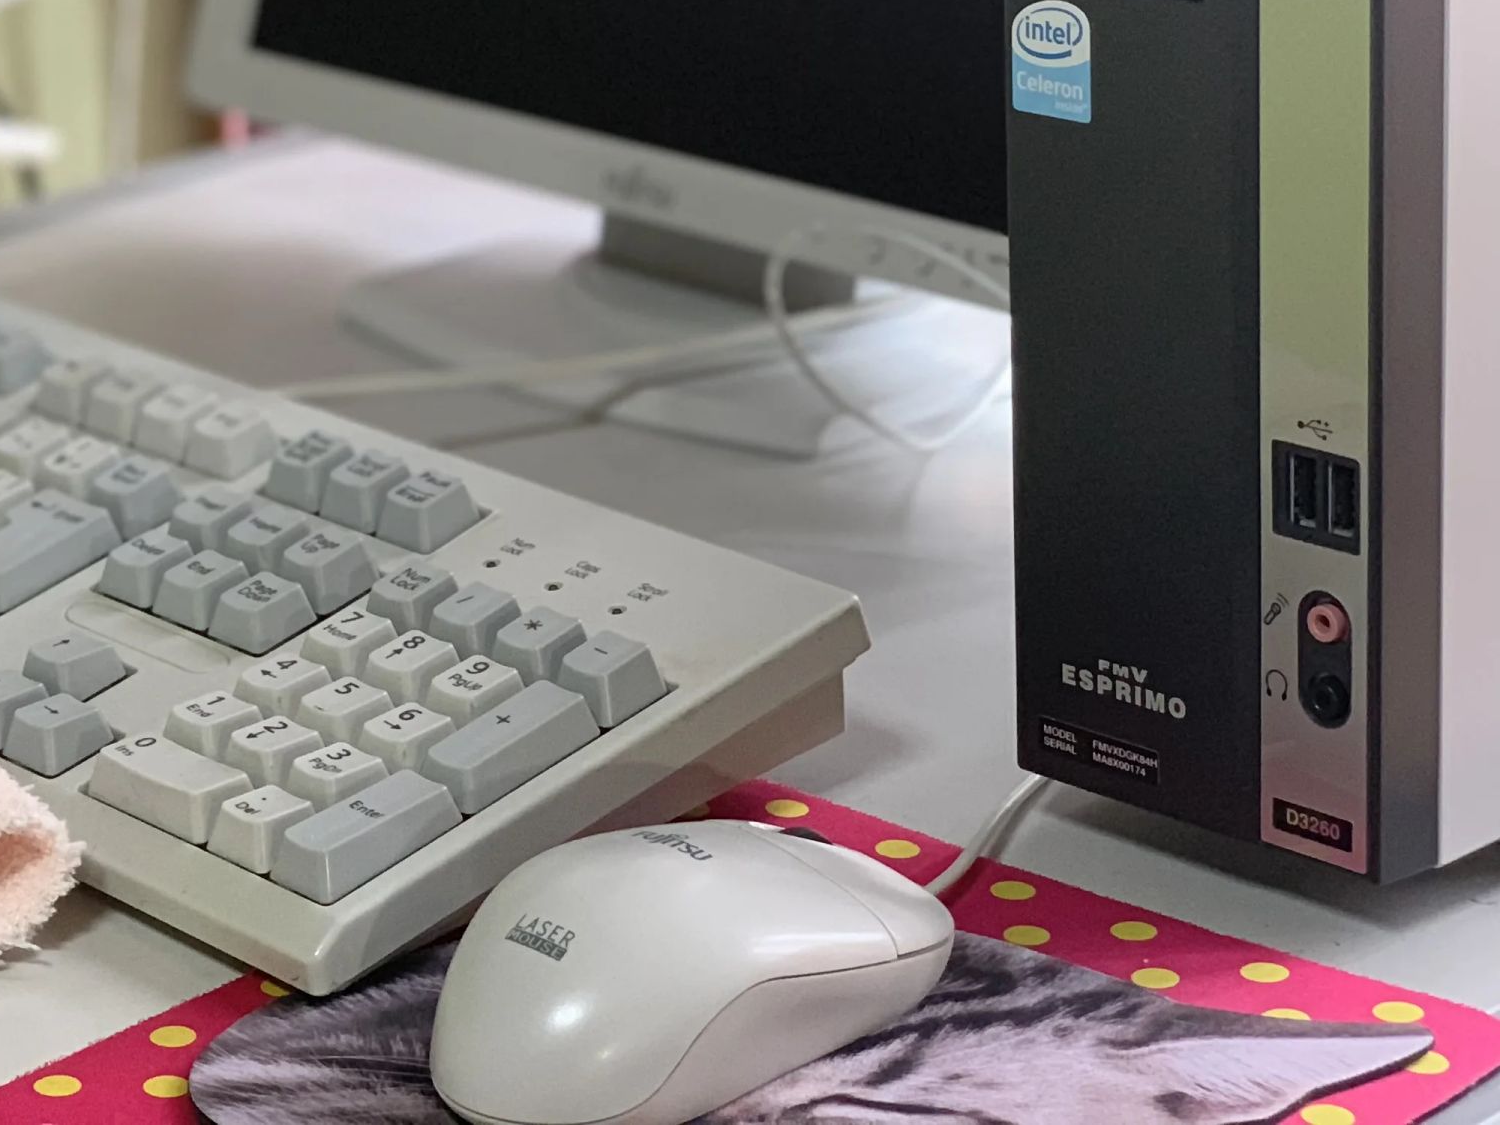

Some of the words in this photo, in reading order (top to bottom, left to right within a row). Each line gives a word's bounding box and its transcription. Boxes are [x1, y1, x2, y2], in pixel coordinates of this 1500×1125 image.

[1025, 15, 1072, 45] intel
[1016, 70, 1084, 100] Celeron
[389, 575, 421, 592] Lock
[403, 567, 432, 584] Num
[340, 611, 364, 624] 7
[322, 623, 358, 641] Home
[403, 635, 426, 649] 8
[276, 658, 298, 670] 4
[465, 661, 490, 675] 9
[1098, 658, 1149, 684] FMV
[334, 681, 360, 695] 5
[447, 672, 484, 692] PgUp
[1061, 662, 1187, 720] ESPRIMO
[206, 695, 226, 706] 1
[185, 702, 214, 718] End
[398, 708, 423, 721] 6
[263, 720, 289, 735] 2
[1043, 723, 1078, 744] MODEL
[134, 736, 157, 748] 0
[1043, 735, 1078, 755] SERIAL
[114, 744, 136, 758] Ins
[325, 748, 352, 761] 3
[234, 800, 262, 815] Del
[348, 799, 386, 820] Enter
[1286, 807, 1340, 841] D3260
[632, 830, 713, 861] FUJITSU
[514, 913, 577, 949] LASER
[506, 928, 567, 961] MOUSE
